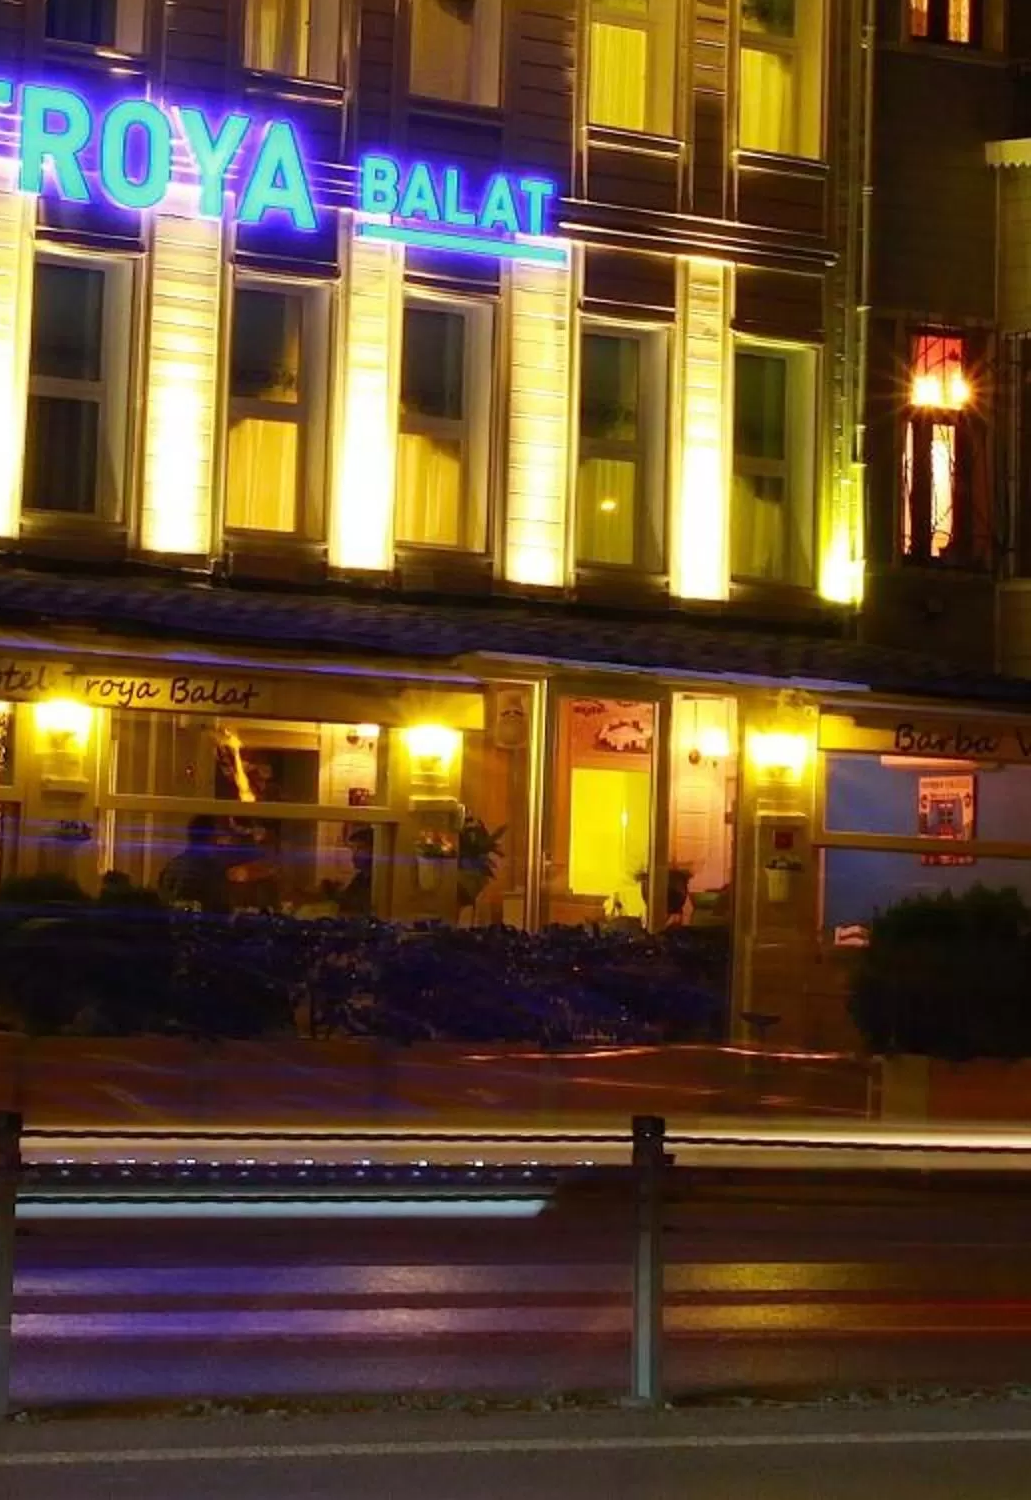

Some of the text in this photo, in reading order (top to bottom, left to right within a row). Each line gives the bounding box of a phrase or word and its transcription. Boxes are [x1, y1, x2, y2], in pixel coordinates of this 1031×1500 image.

[362, 156, 555, 236] BALAT
[170, 676, 259, 708] Balat
[894, 723, 1000, 755] Barba
